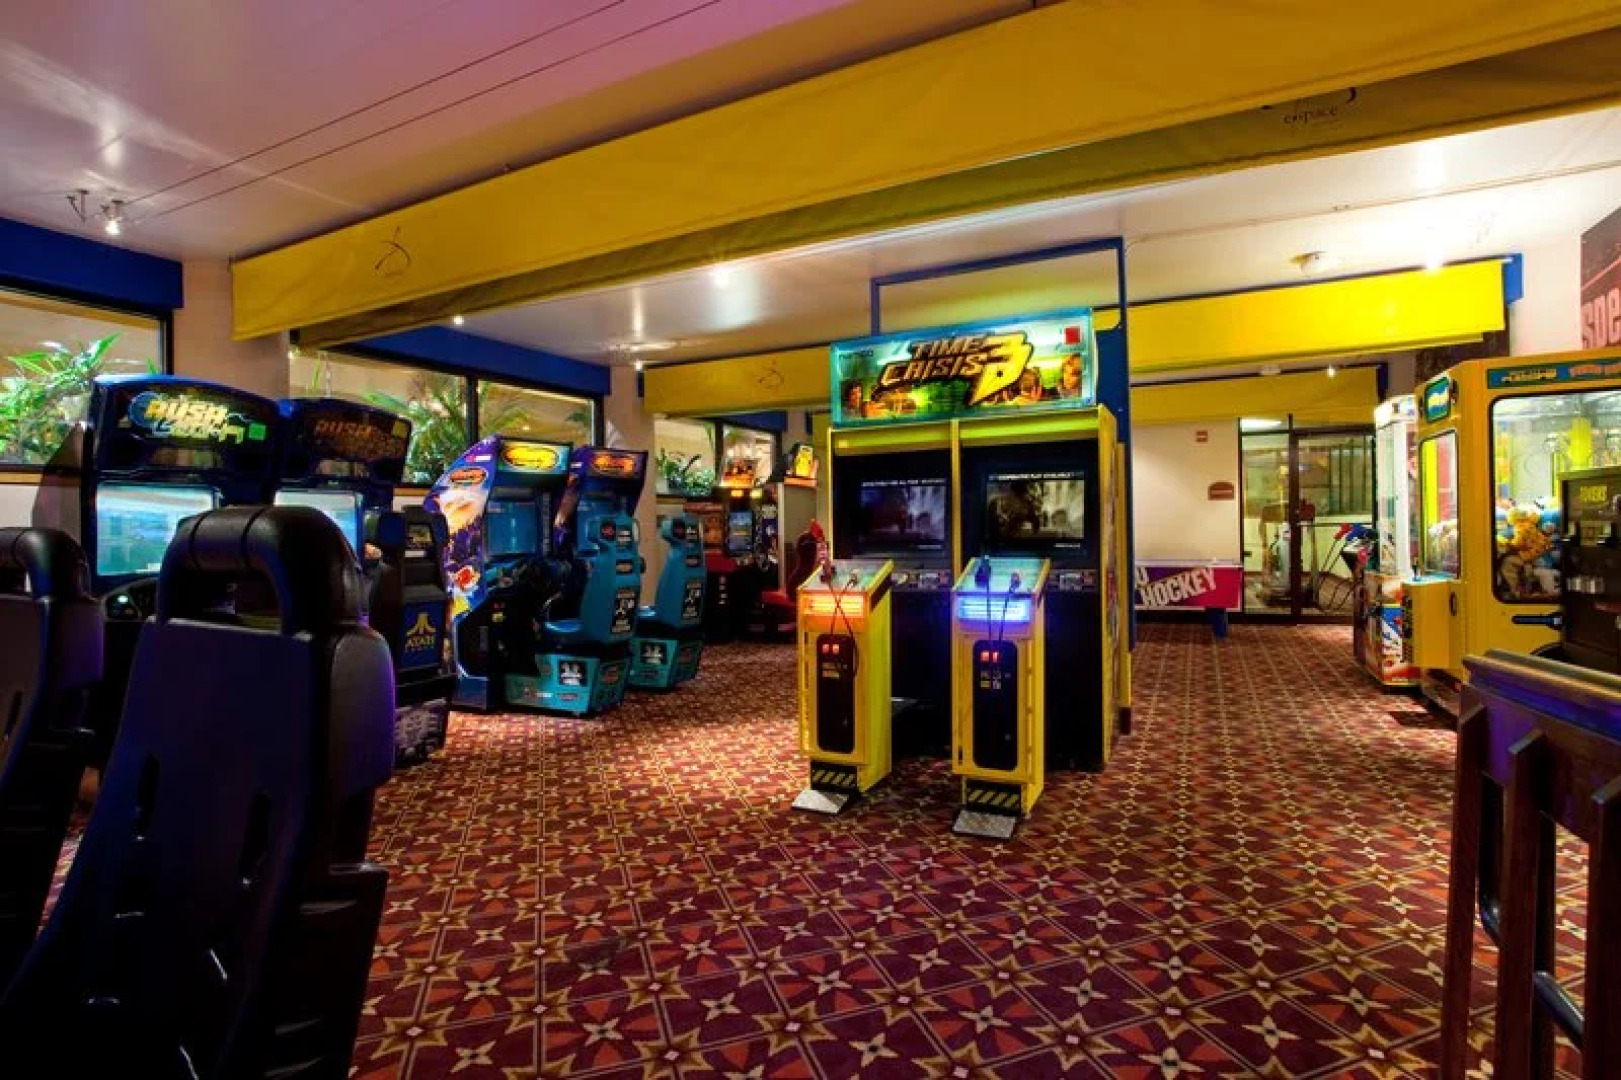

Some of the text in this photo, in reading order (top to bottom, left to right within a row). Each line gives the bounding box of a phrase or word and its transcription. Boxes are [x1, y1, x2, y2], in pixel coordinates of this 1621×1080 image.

[911, 335, 984, 358] TIME
[880, 353, 987, 386] CRISIS
[968, 332, 1033, 406] 3
[145, 398, 229, 425] RUSH
[1140, 566, 1217, 607] HOCKEY
[405, 635, 435, 647] ATARI
